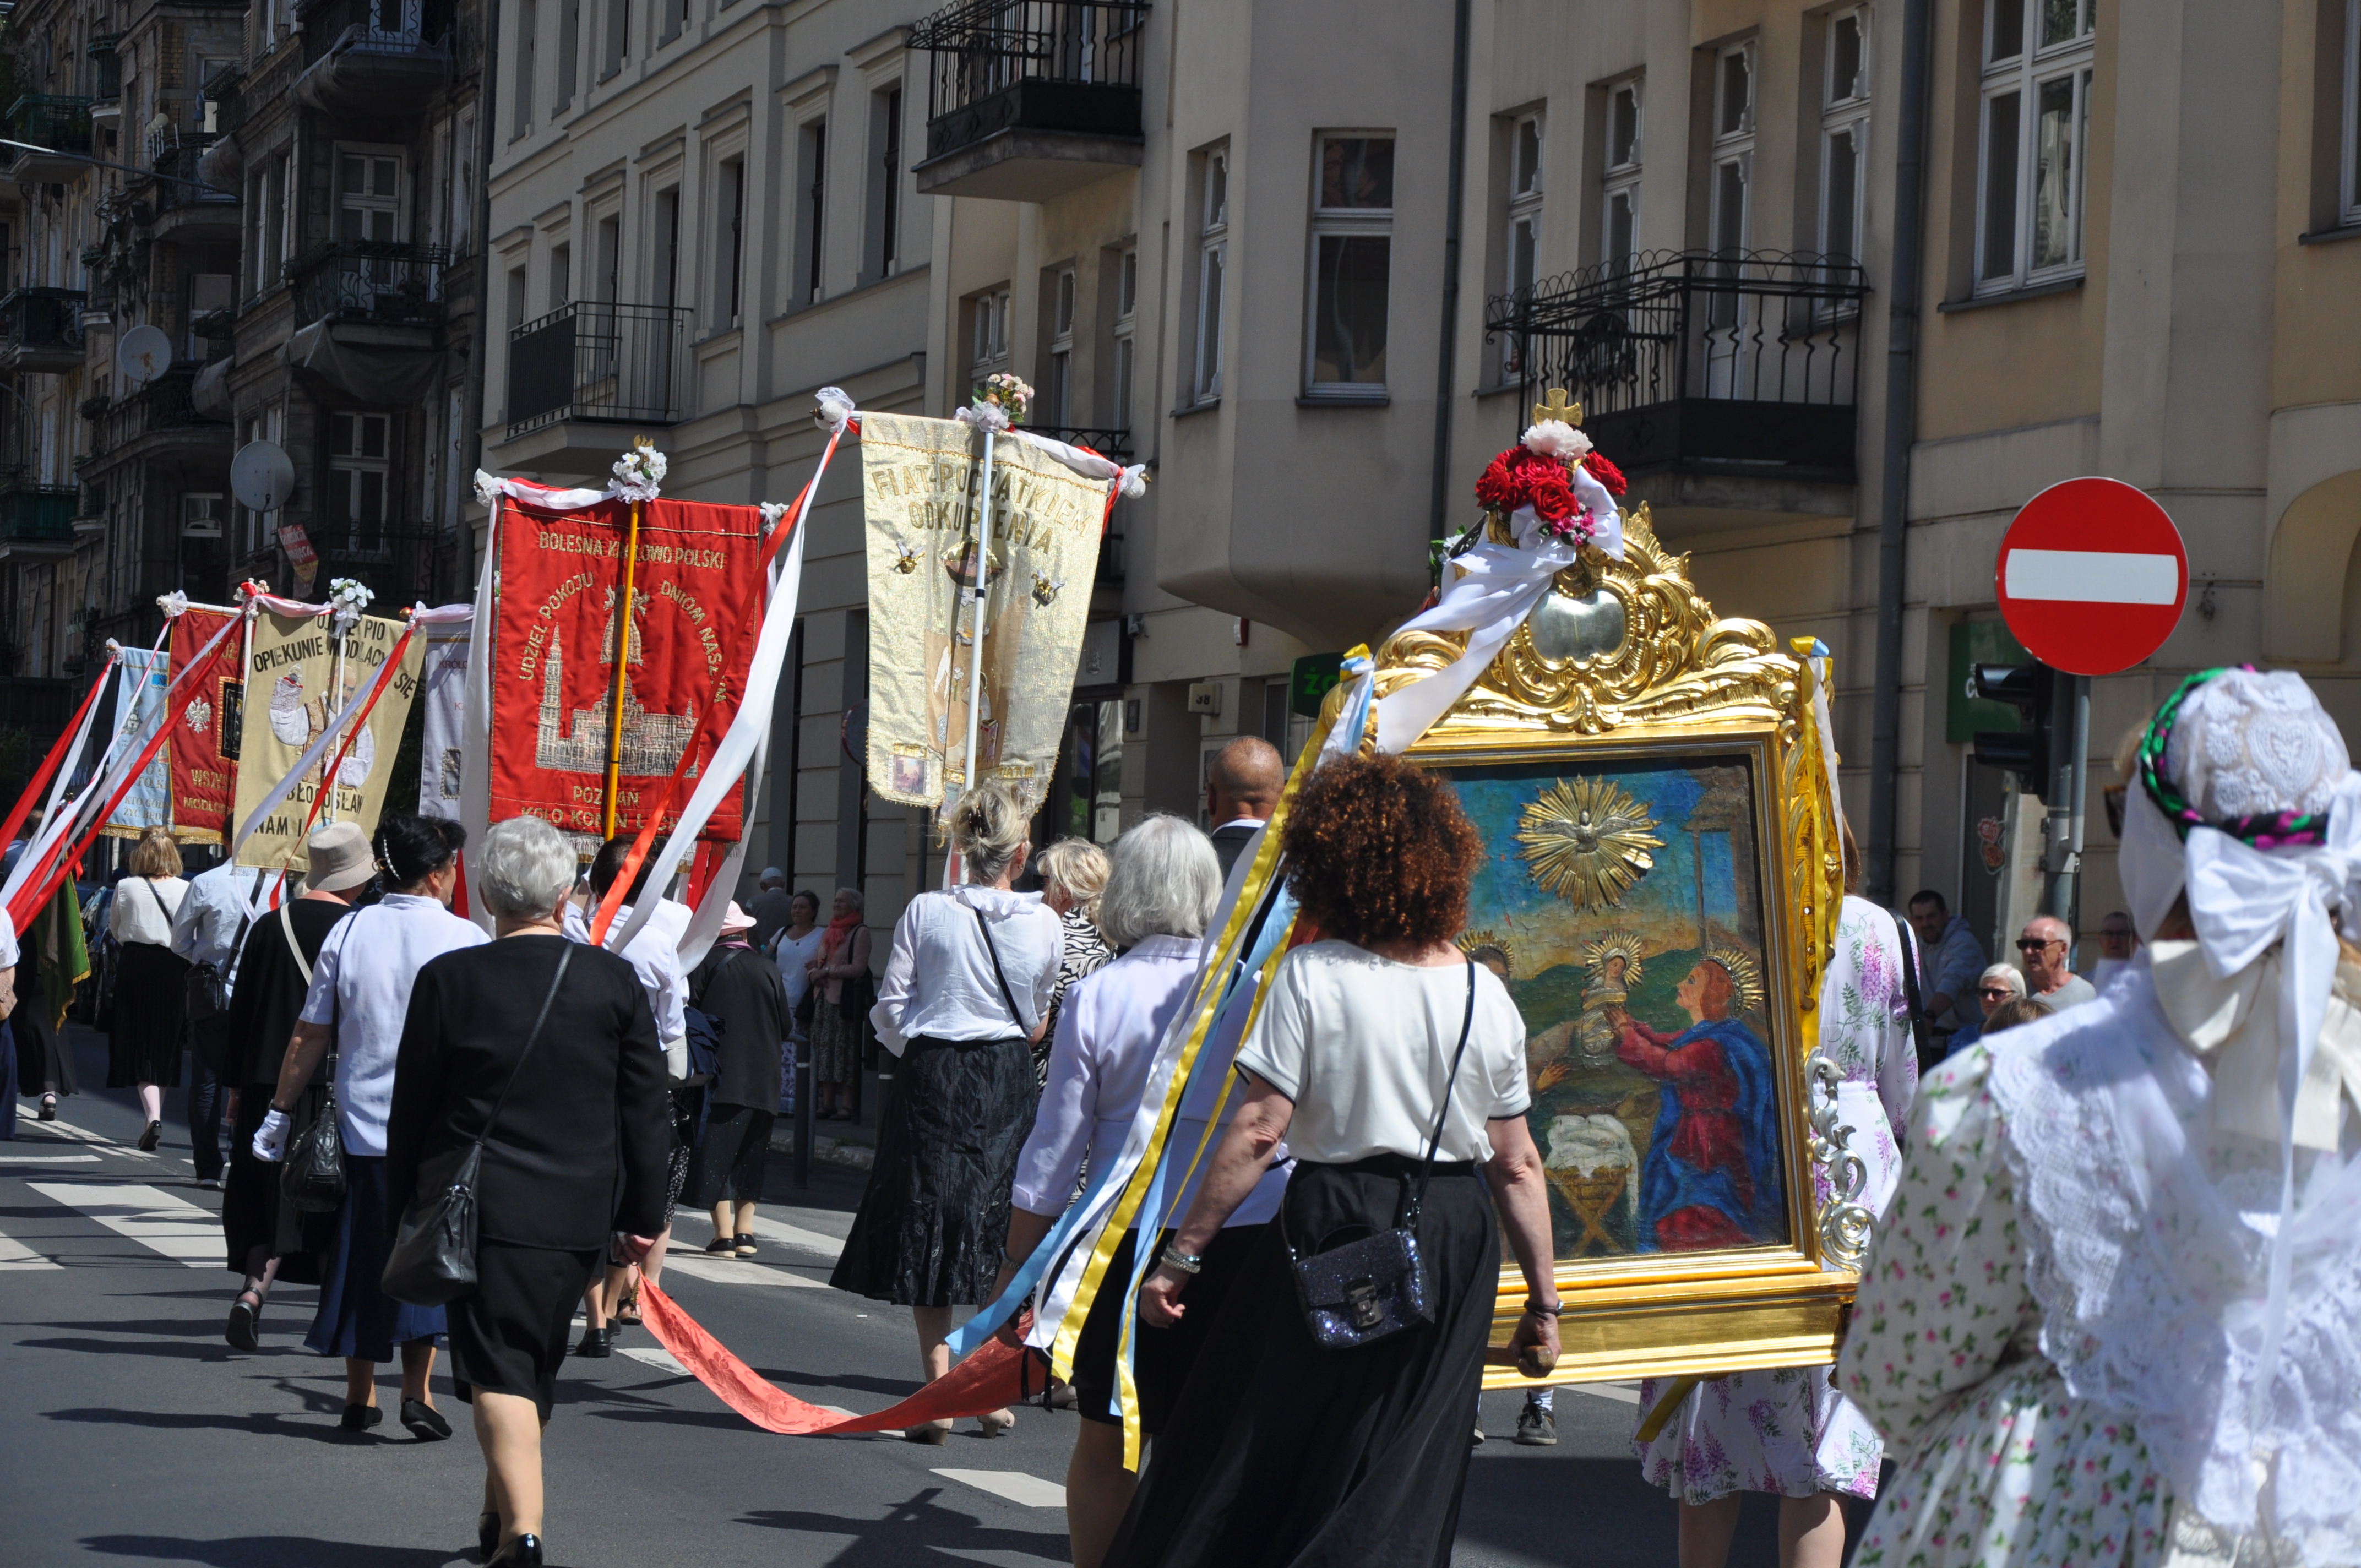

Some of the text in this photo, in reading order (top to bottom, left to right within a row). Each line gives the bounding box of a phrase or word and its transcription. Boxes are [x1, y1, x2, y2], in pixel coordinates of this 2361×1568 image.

[908, 501, 1053, 553] ODKUPENIA
[539, 531, 603, 557] BOLESNA
[674, 547, 724, 569] POLSKI
[364, 619, 385, 640] PIO
[519, 571, 594, 680] UDZIEL POKOJU
[660, 580, 727, 703] DNIOM NASZM
[253, 636, 323, 672] OPIEKUNIE
[394, 672, 417, 699] SIĘ
[439, 658, 468, 669] KRÓLO
[255, 815, 289, 836] NAM
